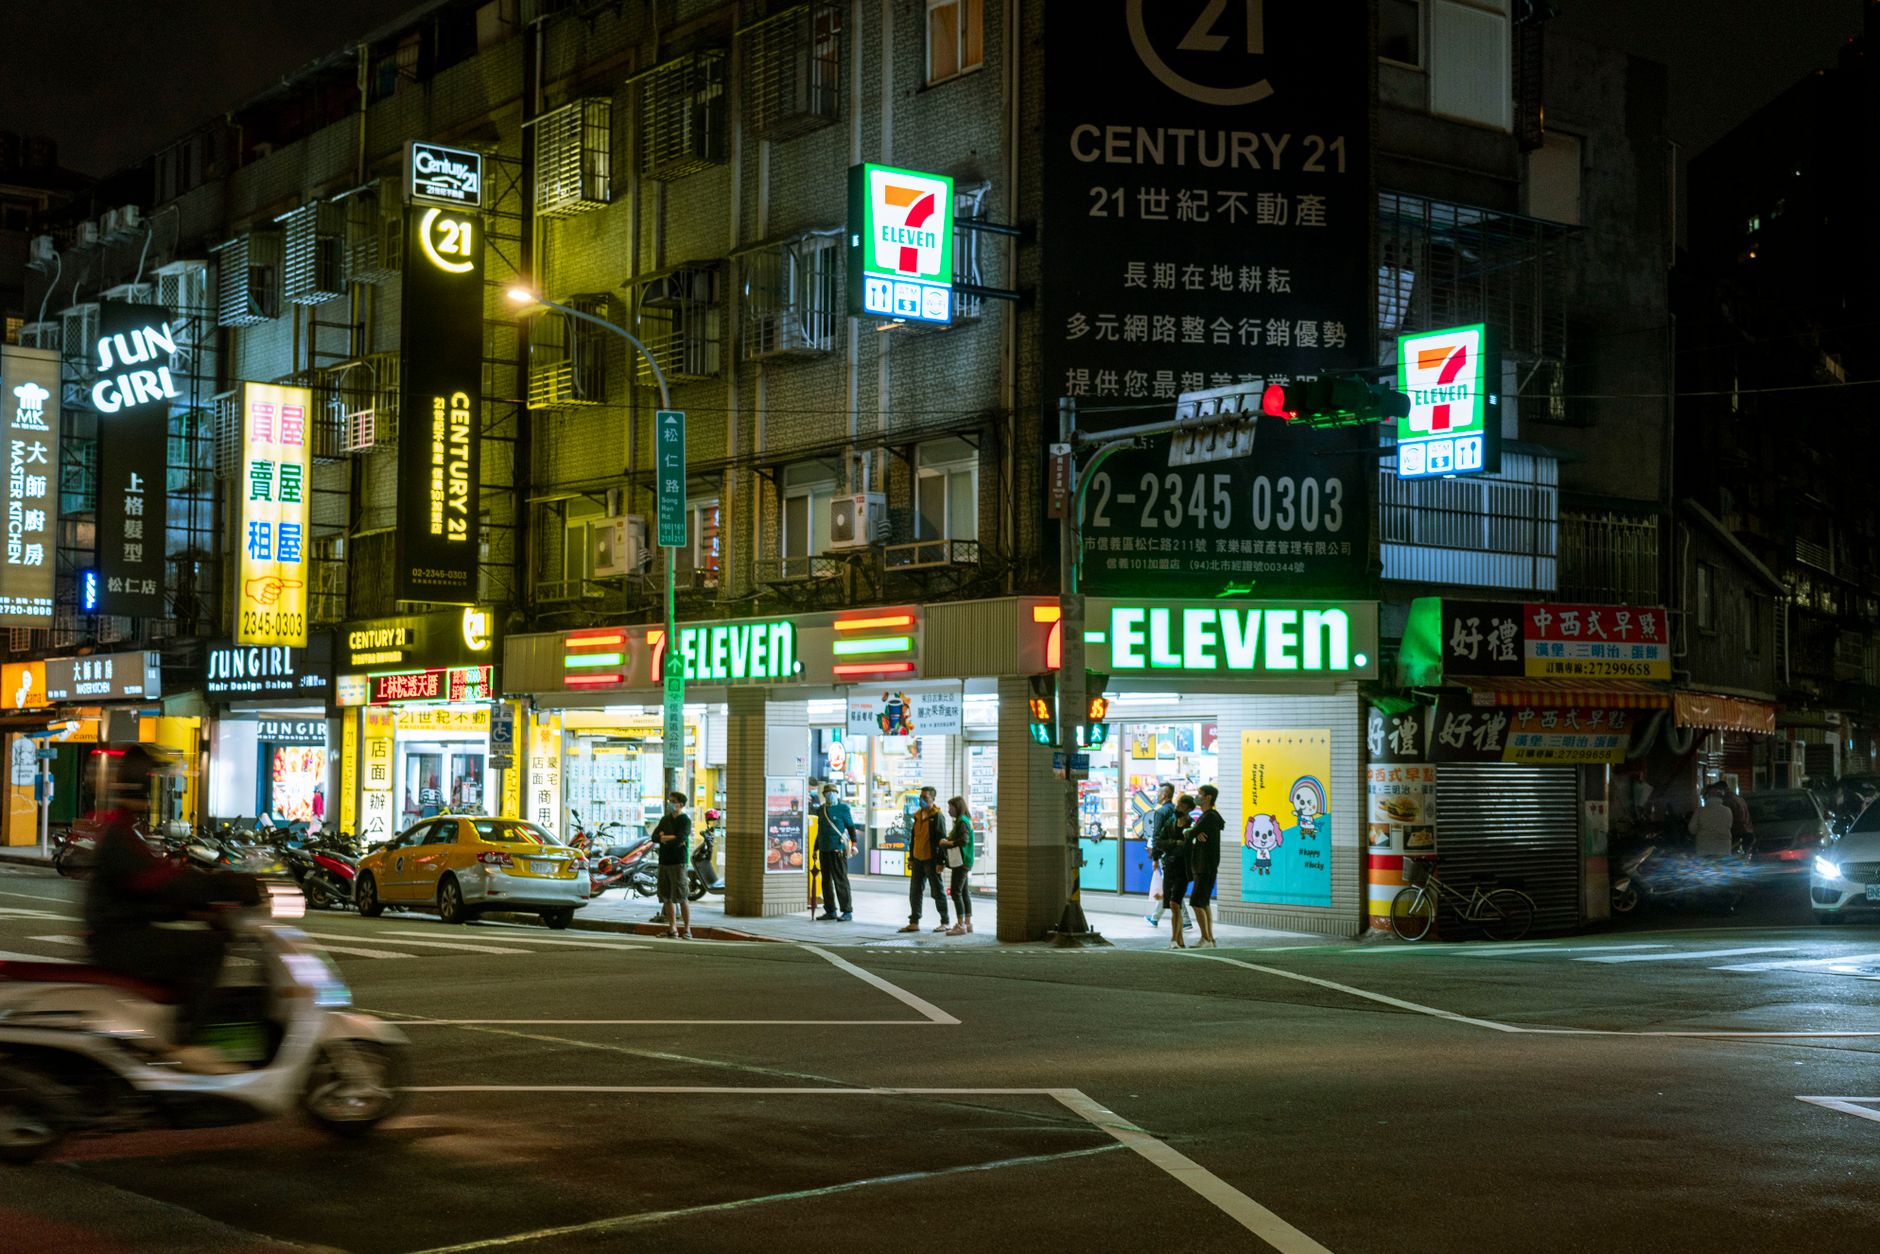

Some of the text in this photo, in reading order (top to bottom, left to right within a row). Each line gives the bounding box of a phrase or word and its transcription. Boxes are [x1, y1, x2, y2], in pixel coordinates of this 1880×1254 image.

[1070, 123, 1347, 174] CENTURY 21
[416, 151, 478, 193] Century 21
[1088, 186, 1328, 228] 21世紀不動產
[1123, 261, 1292, 294] 長期在地耕耘
[97, 321, 179, 372] SUN
[1065, 312, 1348, 349] 多元網路整合行銷優勢
[91, 365, 182, 413] GIRL
[16, 408, 45, 424] MK
[250, 402, 304, 447] 買屋
[249, 459, 303, 504] 賣屋
[448, 391, 470, 541] CENTURY 21
[664, 428, 679, 493] 松仁路
[8, 440, 25, 565] MASTER KITCHEN
[24, 441, 48, 566] 大師廚房
[122, 472, 145, 564] 上格髮型
[1252, 475, 1344, 533] 0303
[247, 520, 302, 564] 租屋
[107, 576, 157, 596] 松仁店
[243, 610, 303, 637] 2345-0303
[349, 627, 406, 649] CENTURY 21
[1449, 617, 1519, 662] 好禮
[1532, 607, 1659, 641] 中西式早點
[208, 681, 228, 691] Hair
[230, 681, 262, 692] Design
[265, 680, 293, 690] Salon
[1438, 711, 1507, 752] 好禮
[1517, 707, 1626, 730] 中西式早點
